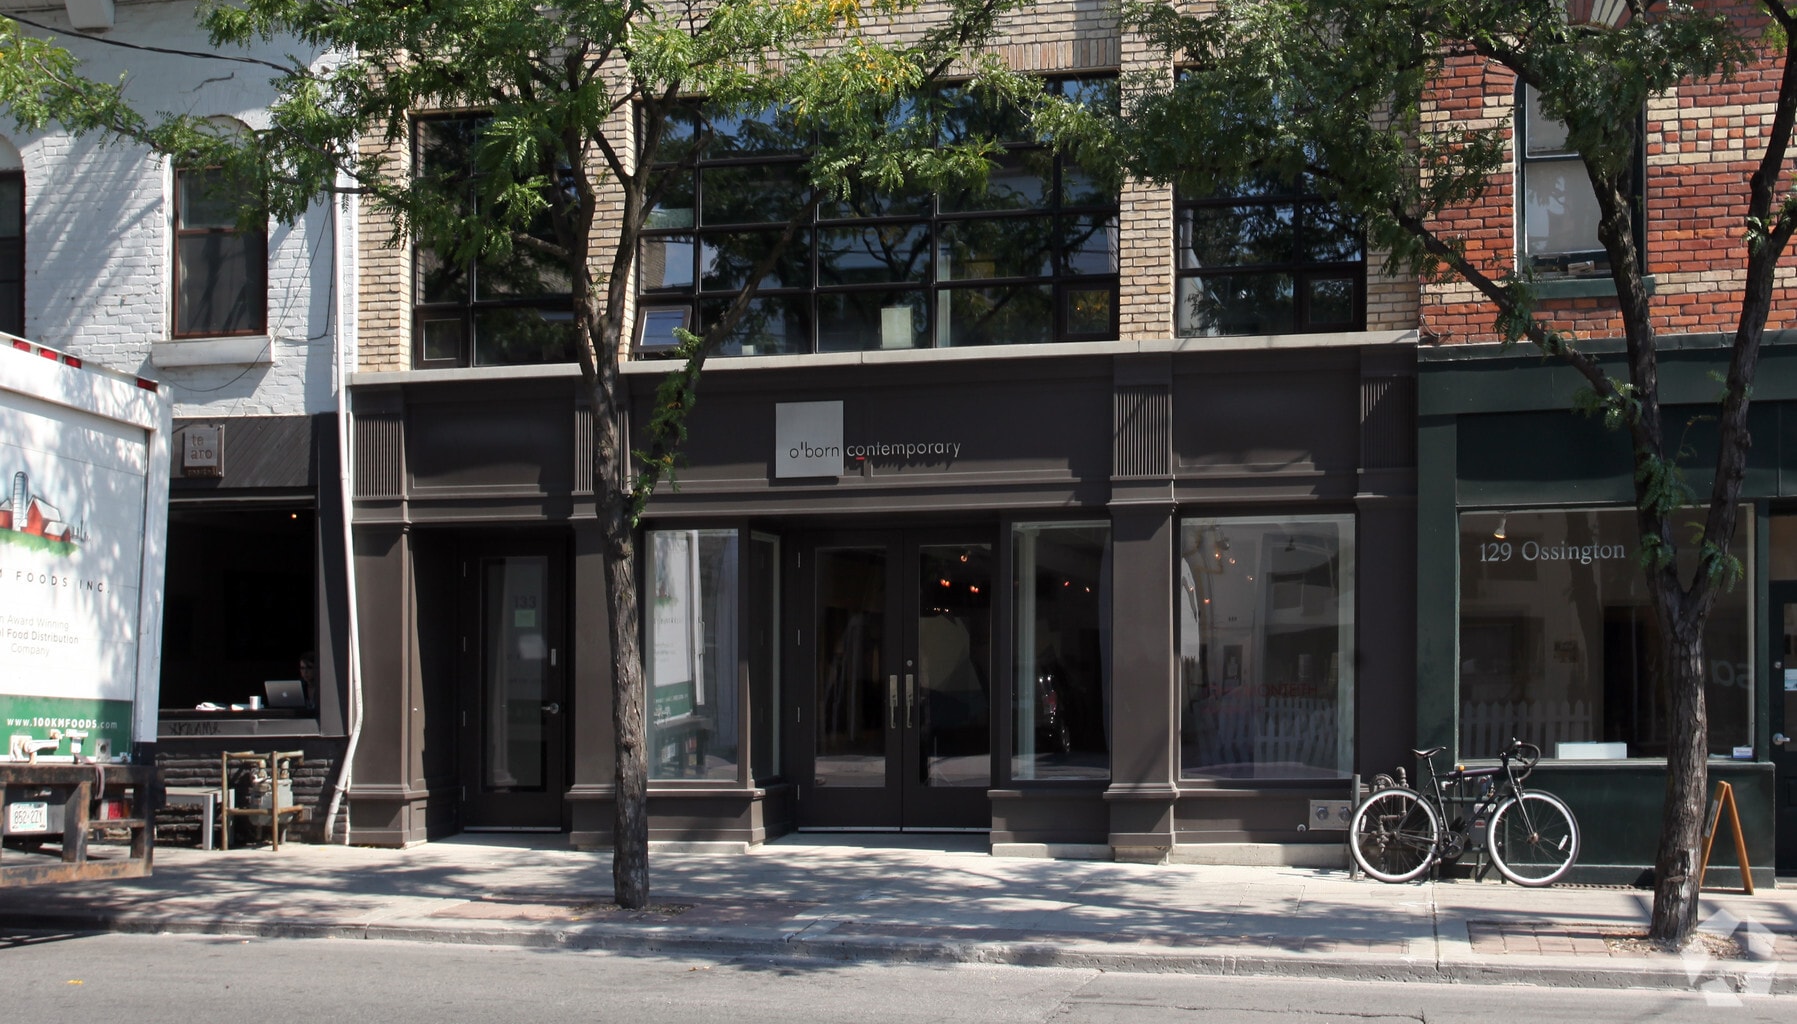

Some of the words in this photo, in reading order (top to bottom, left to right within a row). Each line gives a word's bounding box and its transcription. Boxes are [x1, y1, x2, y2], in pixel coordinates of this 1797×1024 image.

[191, 433, 204, 447] te
[190, 448, 213, 460] aro
[789, 441, 840, 459] o'born
[846, 441, 961, 458] contemporary
[1479, 541, 1512, 563] 129
[1521, 540, 1626, 565] Ossington
[16, 570, 68, 588] FOODS
[513, 595, 537, 608] 133
[7, 615, 34, 627] Award
[37, 617, 69, 632] Winning
[7, 628, 29, 640] Food
[31, 630, 79, 645] Distribution
[10, 642, 49, 657] Company
[7, 717, 118, 729] www.100KMFOODS.com
